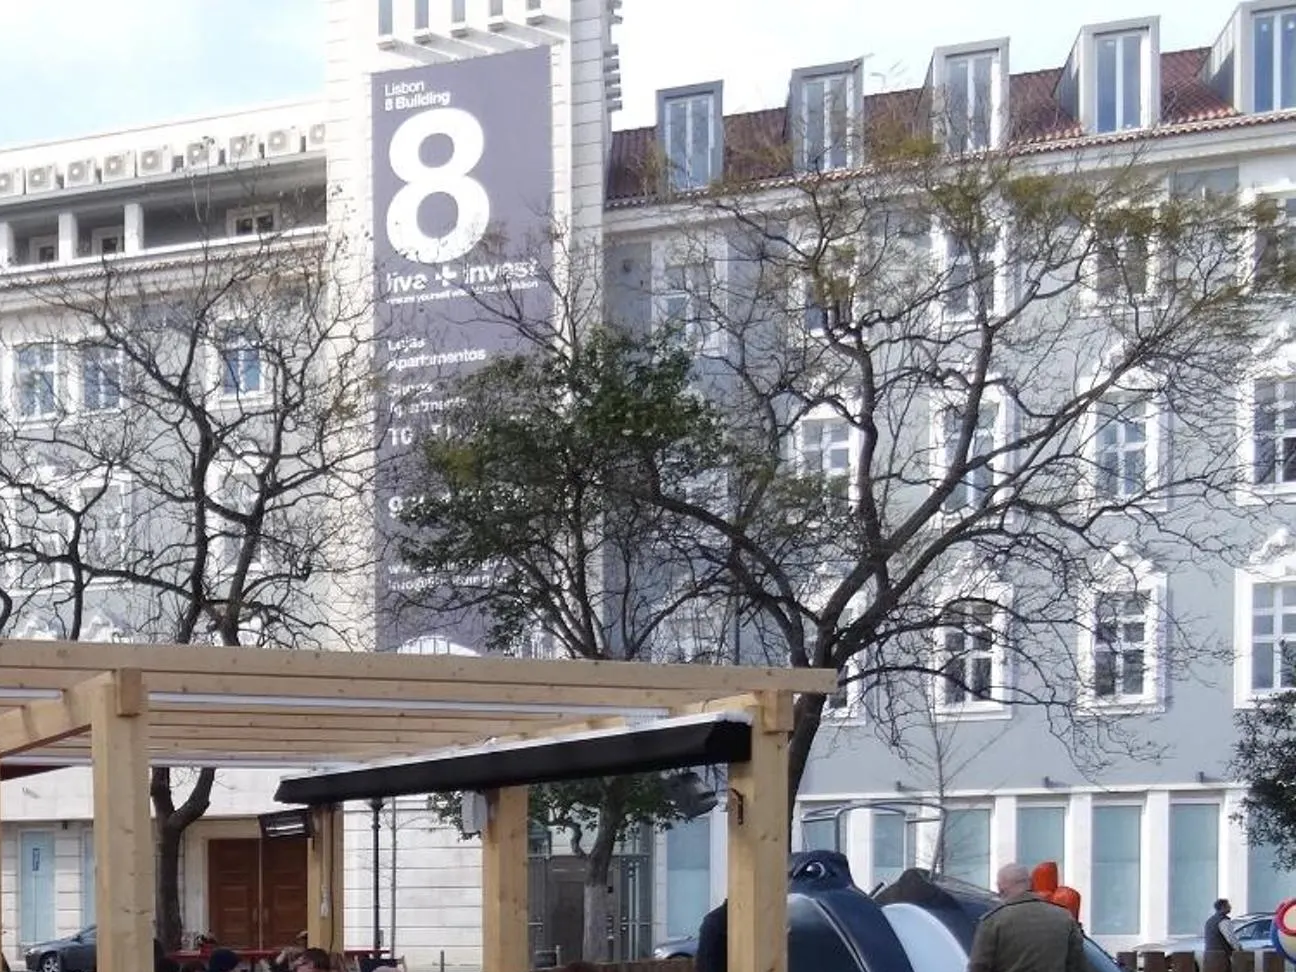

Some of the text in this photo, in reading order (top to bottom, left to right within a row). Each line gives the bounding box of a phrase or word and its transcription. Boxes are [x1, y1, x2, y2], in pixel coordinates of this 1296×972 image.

[384, 80, 424, 97] Lisbon
[395, 91, 451, 109] Building
[387, 107, 490, 264] 8
[387, 349, 486, 372] Apartamentos
